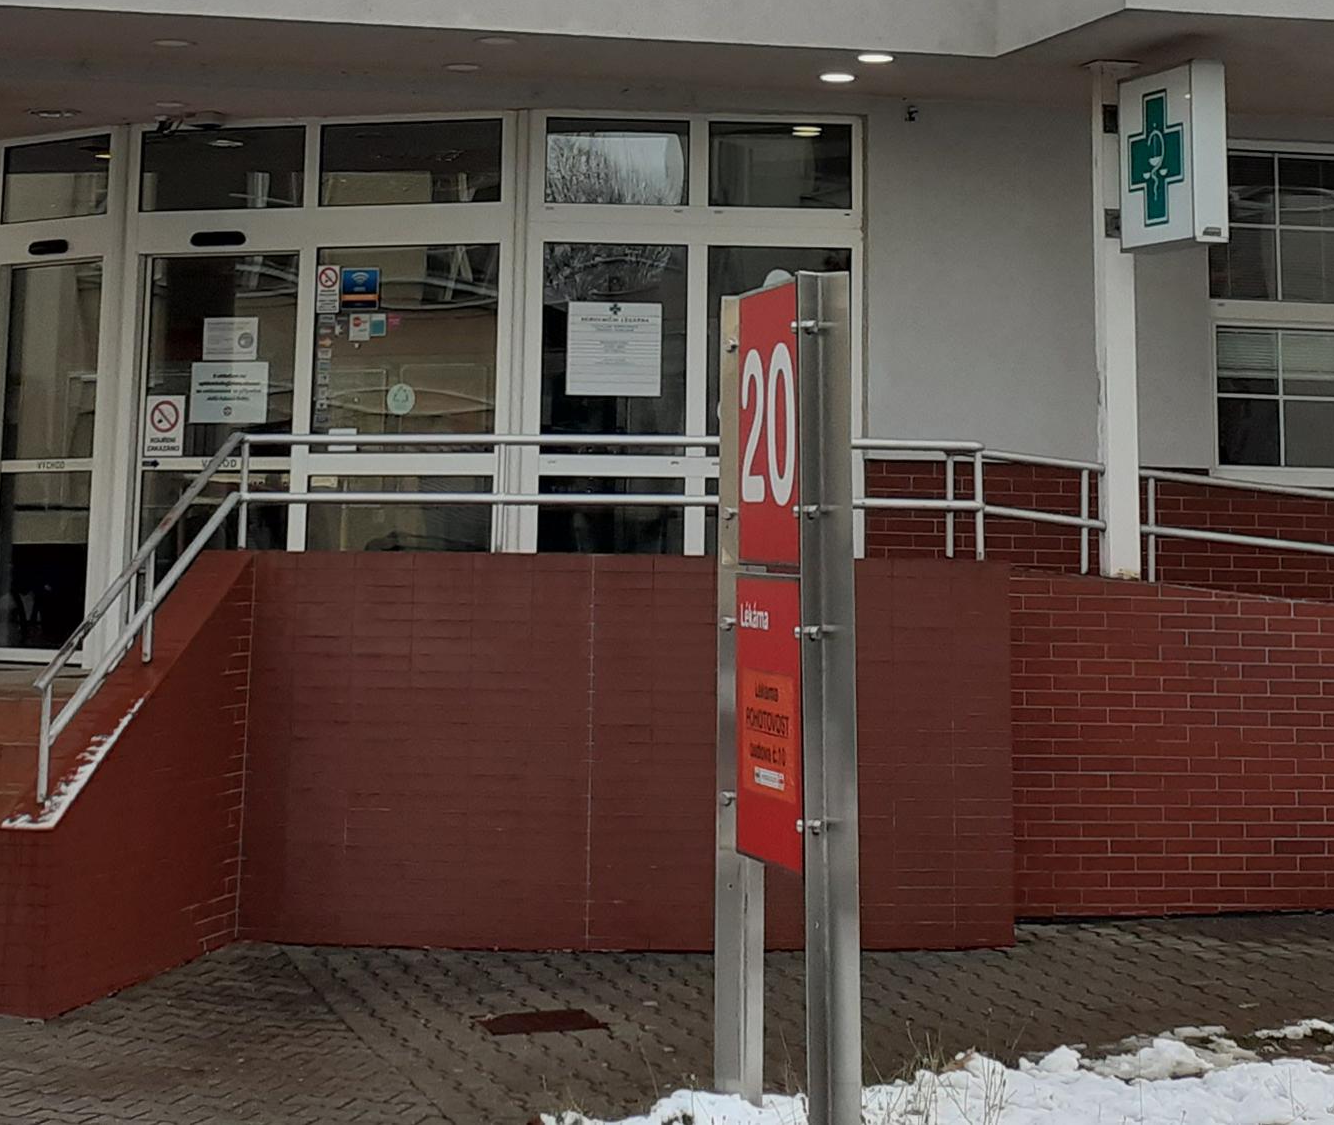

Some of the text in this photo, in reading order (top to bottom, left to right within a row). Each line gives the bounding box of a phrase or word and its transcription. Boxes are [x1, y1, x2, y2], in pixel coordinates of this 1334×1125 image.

[742, 342, 795, 506] 20
[740, 603, 769, 631] Lékárna
[746, 707, 789, 736] POHOTOVOST
